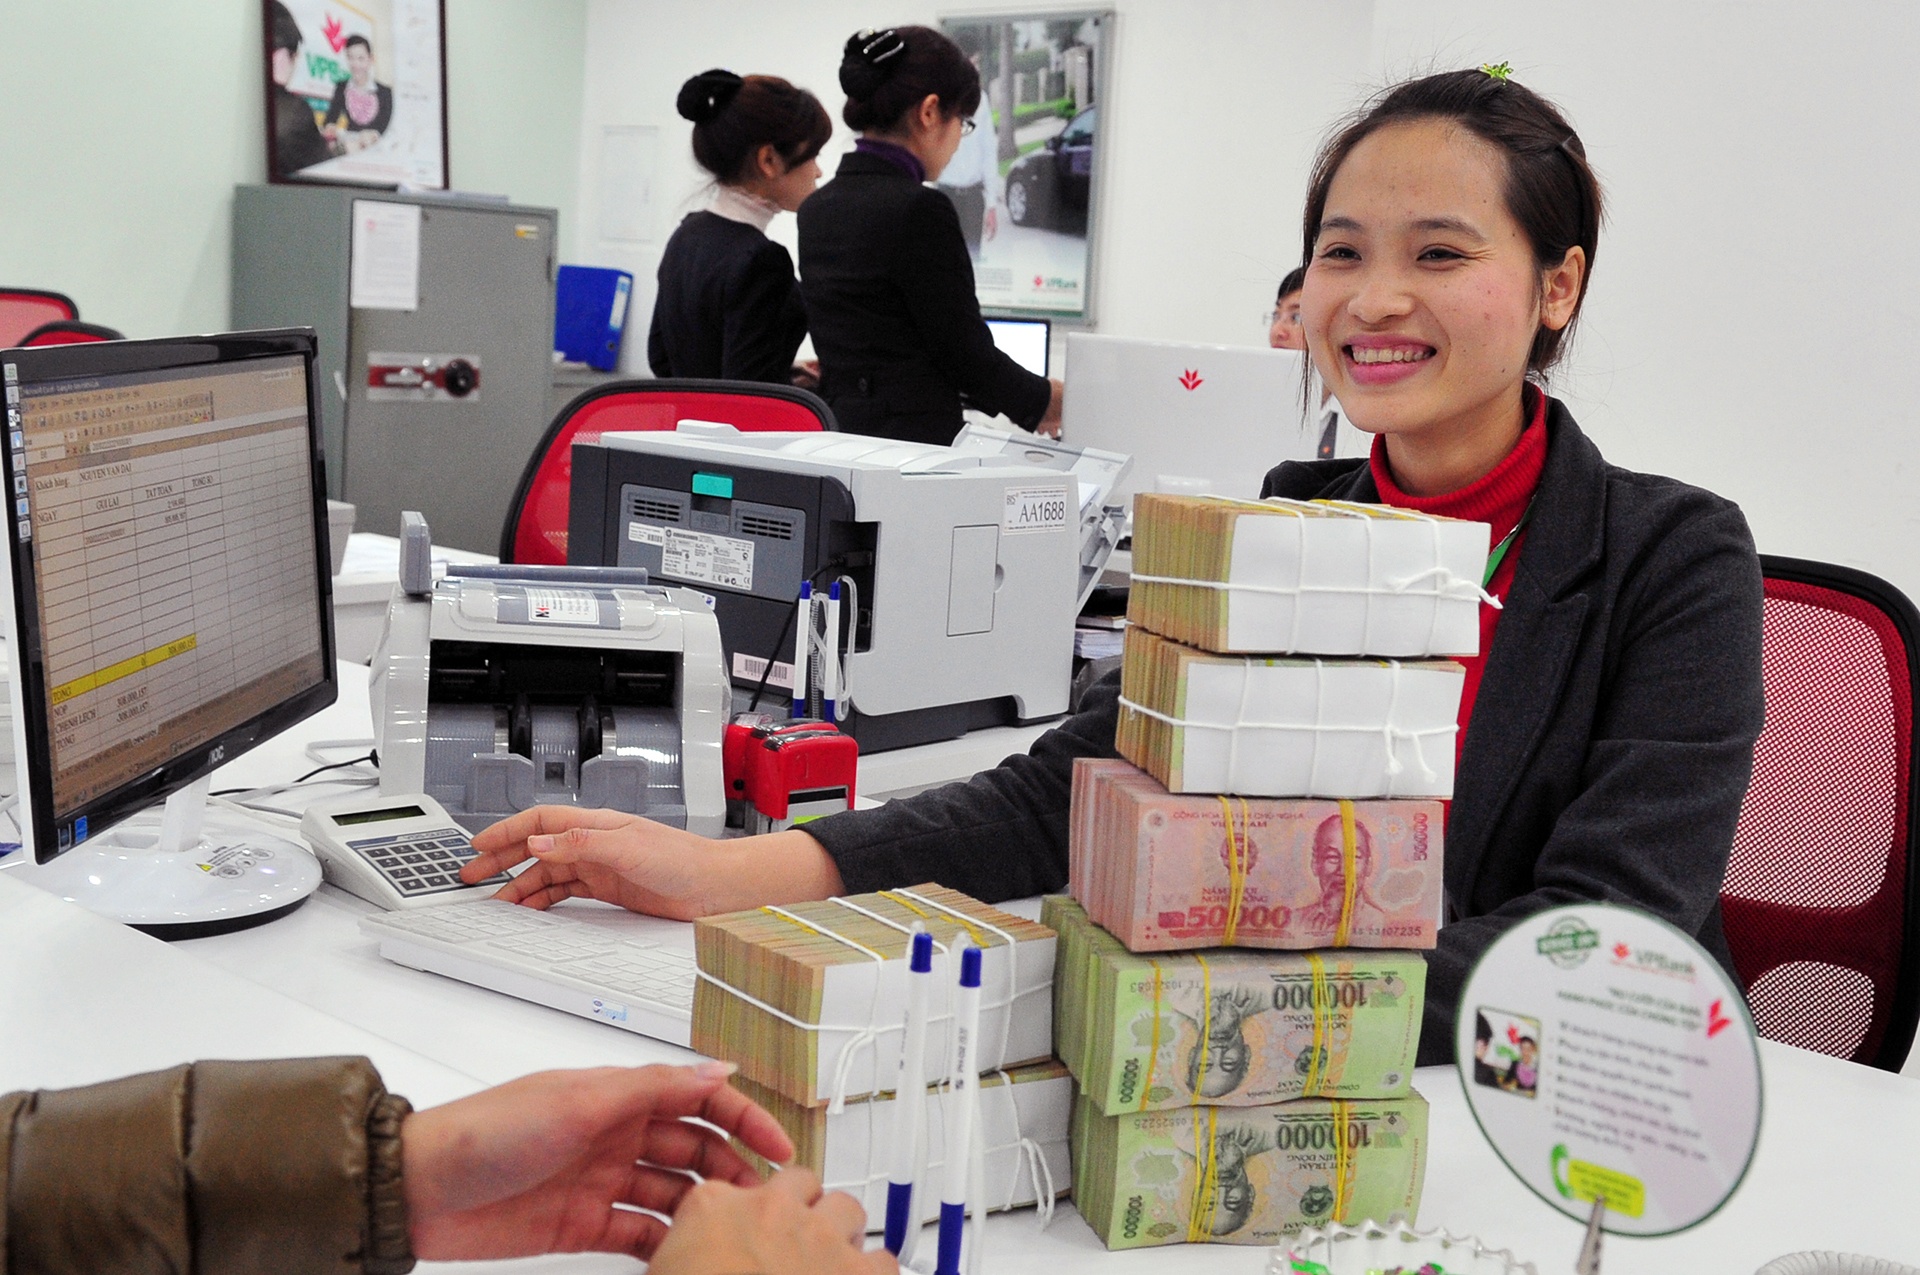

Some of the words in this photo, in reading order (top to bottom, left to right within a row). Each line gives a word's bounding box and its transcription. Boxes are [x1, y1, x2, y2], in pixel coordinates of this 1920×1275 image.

[1019, 501, 1065, 523] AA1688
[1119, 1057, 1140, 1104] 100000
[1122, 1194, 1143, 1240] 100000
